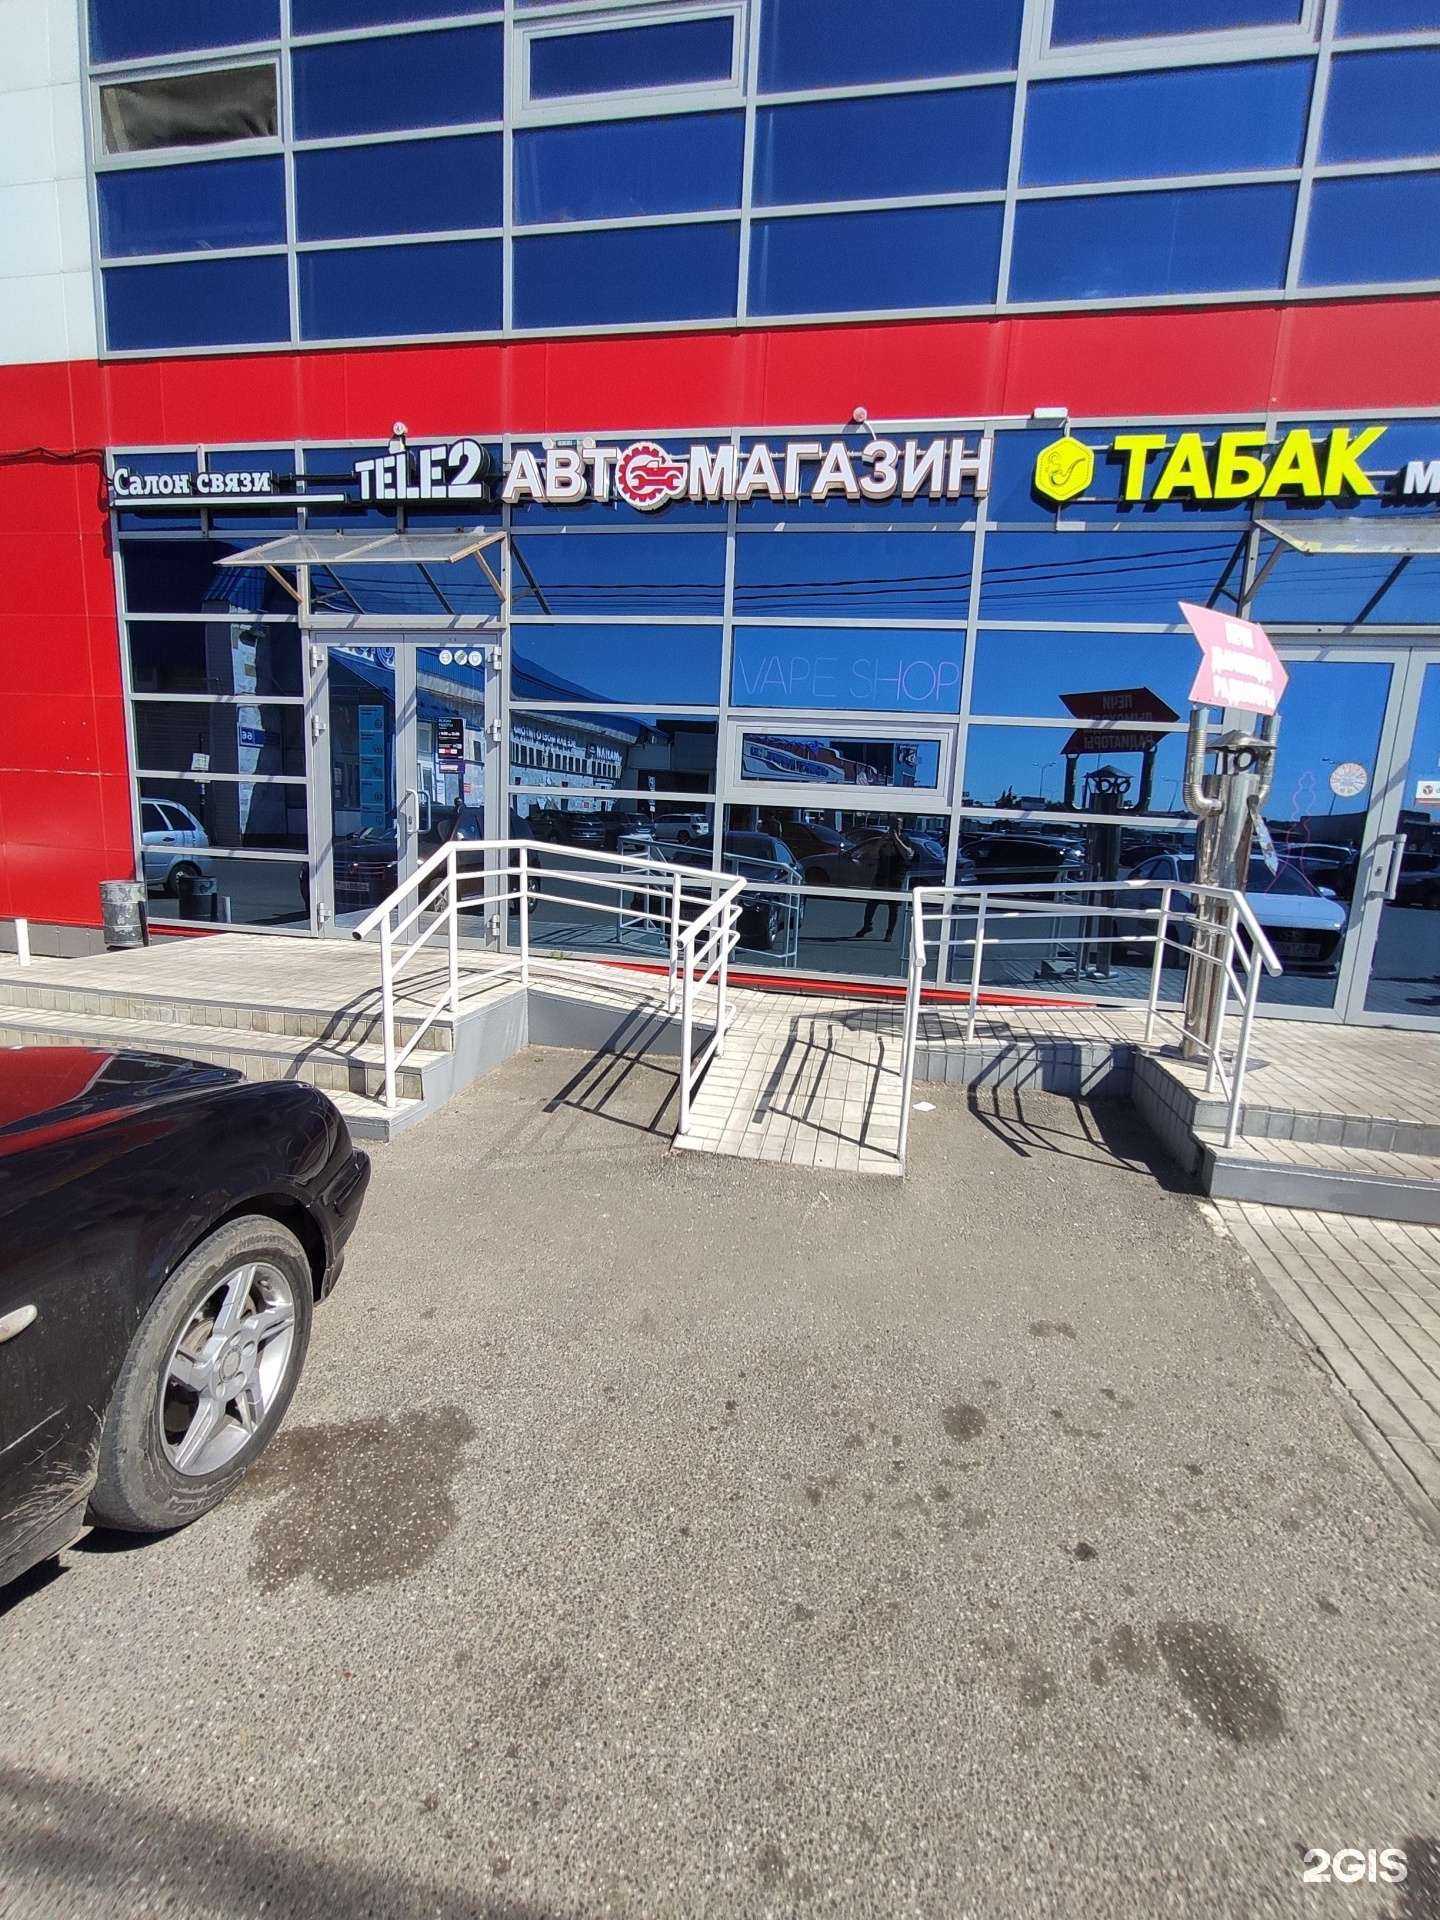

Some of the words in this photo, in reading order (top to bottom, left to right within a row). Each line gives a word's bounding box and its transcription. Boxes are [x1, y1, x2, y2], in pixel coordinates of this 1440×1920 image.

[112, 467, 190, 496] Салон
[196, 470, 272, 494] связи
[354, 439, 484, 500] TELE2
[1113, 426, 1388, 500] ТАБАК
[738, 655, 838, 698] VAPE
[851, 657, 960, 701] SHOP
